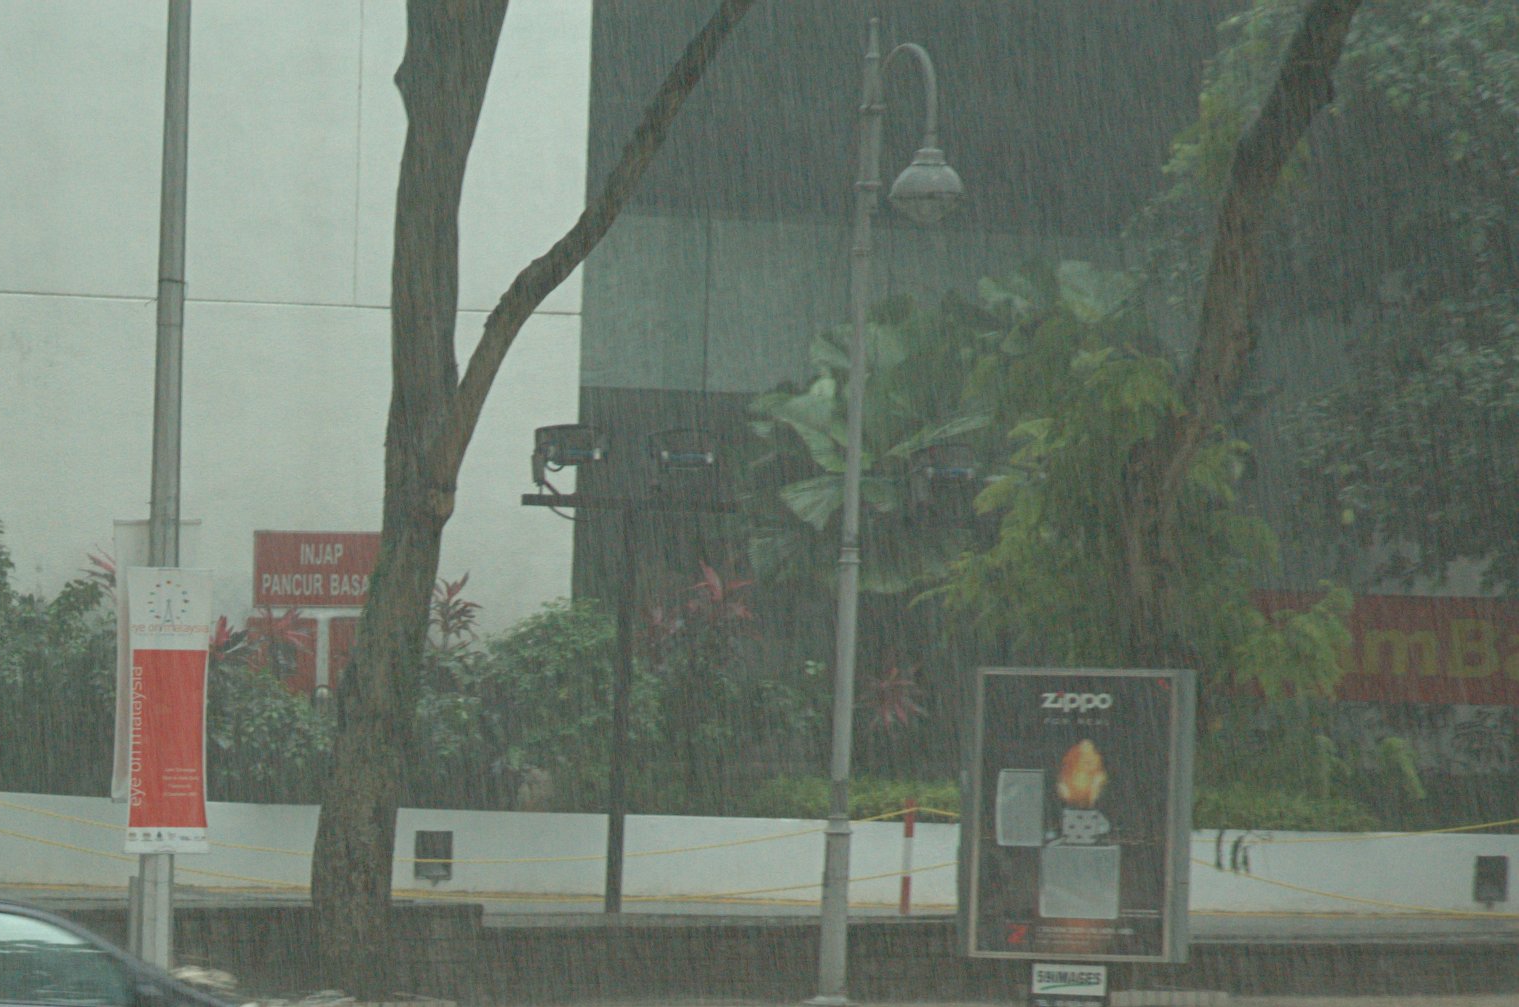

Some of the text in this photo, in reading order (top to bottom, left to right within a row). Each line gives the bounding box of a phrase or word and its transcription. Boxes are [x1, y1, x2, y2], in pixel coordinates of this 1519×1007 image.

[300, 543, 343, 565] INJAP
[261, 573, 369, 595] PANCUR BASA
[130, 666, 146, 808] eye on malaysia
